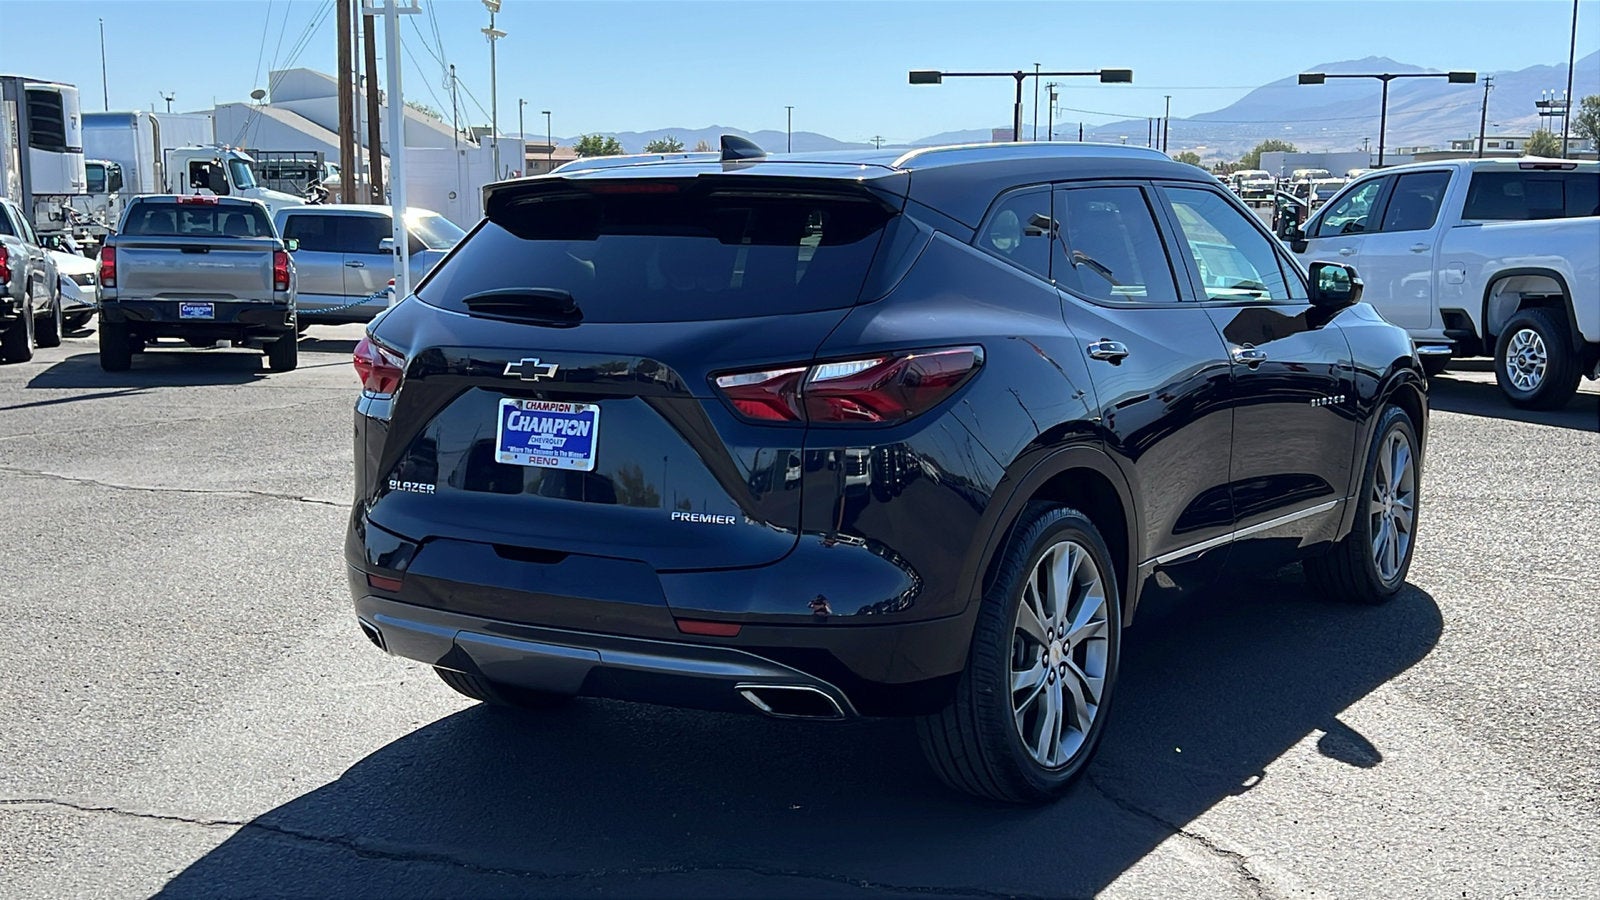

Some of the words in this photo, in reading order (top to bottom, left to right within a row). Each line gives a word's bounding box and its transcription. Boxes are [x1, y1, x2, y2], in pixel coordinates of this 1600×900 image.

[526, 401, 572, 412] CHAMPION
[507, 411, 591, 437] CHAMPION
[531, 436, 564, 445] CHEVROLET
[528, 456, 559, 466] RENO
[389, 480, 435, 494] BLAZER
[671, 511, 736, 525] PREMIER
